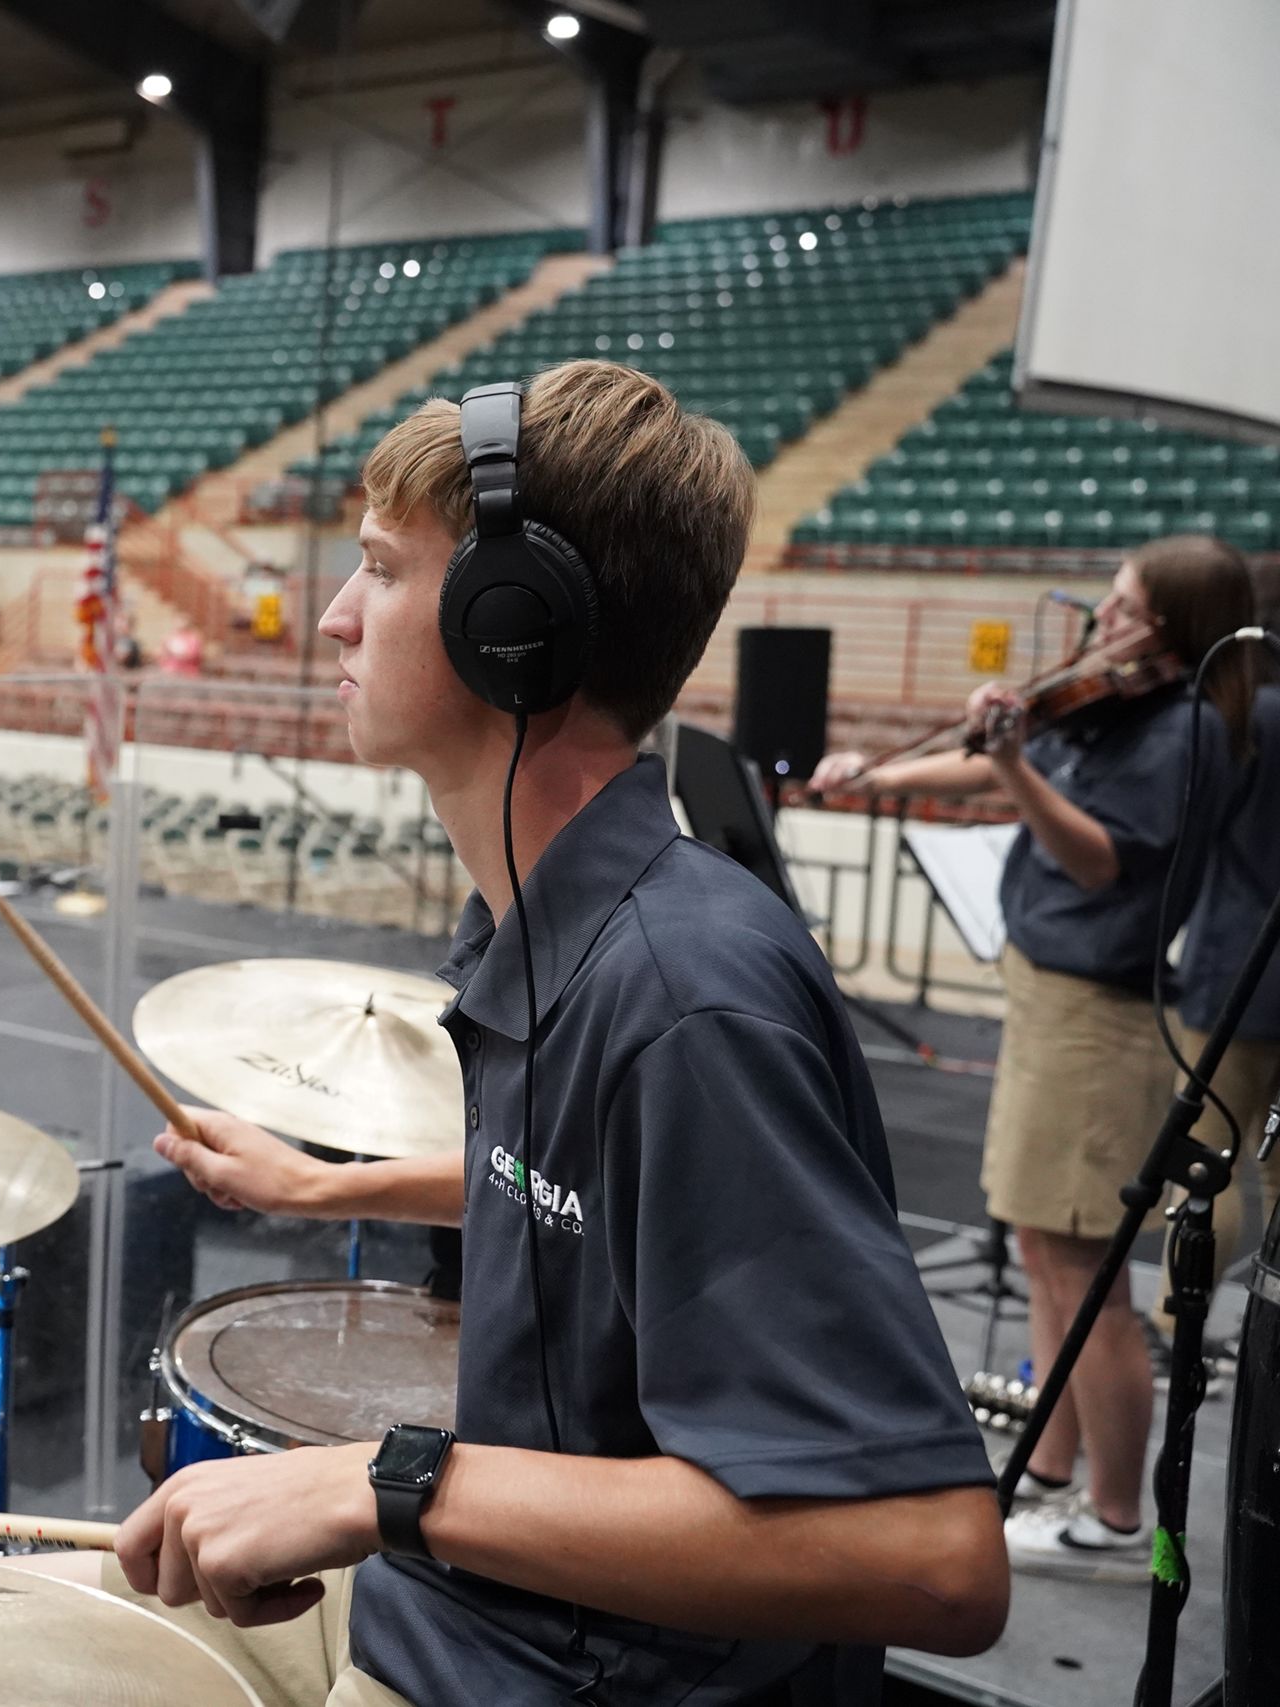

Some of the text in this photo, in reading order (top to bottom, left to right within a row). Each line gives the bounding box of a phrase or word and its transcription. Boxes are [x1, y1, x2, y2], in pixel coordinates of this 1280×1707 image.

[491, 641, 544, 653] SENNHEISER
[507, 1185, 541, 1220] CLOS
[544, 1213, 554, 1227] &
[561, 1218, 585, 1236] CO.
